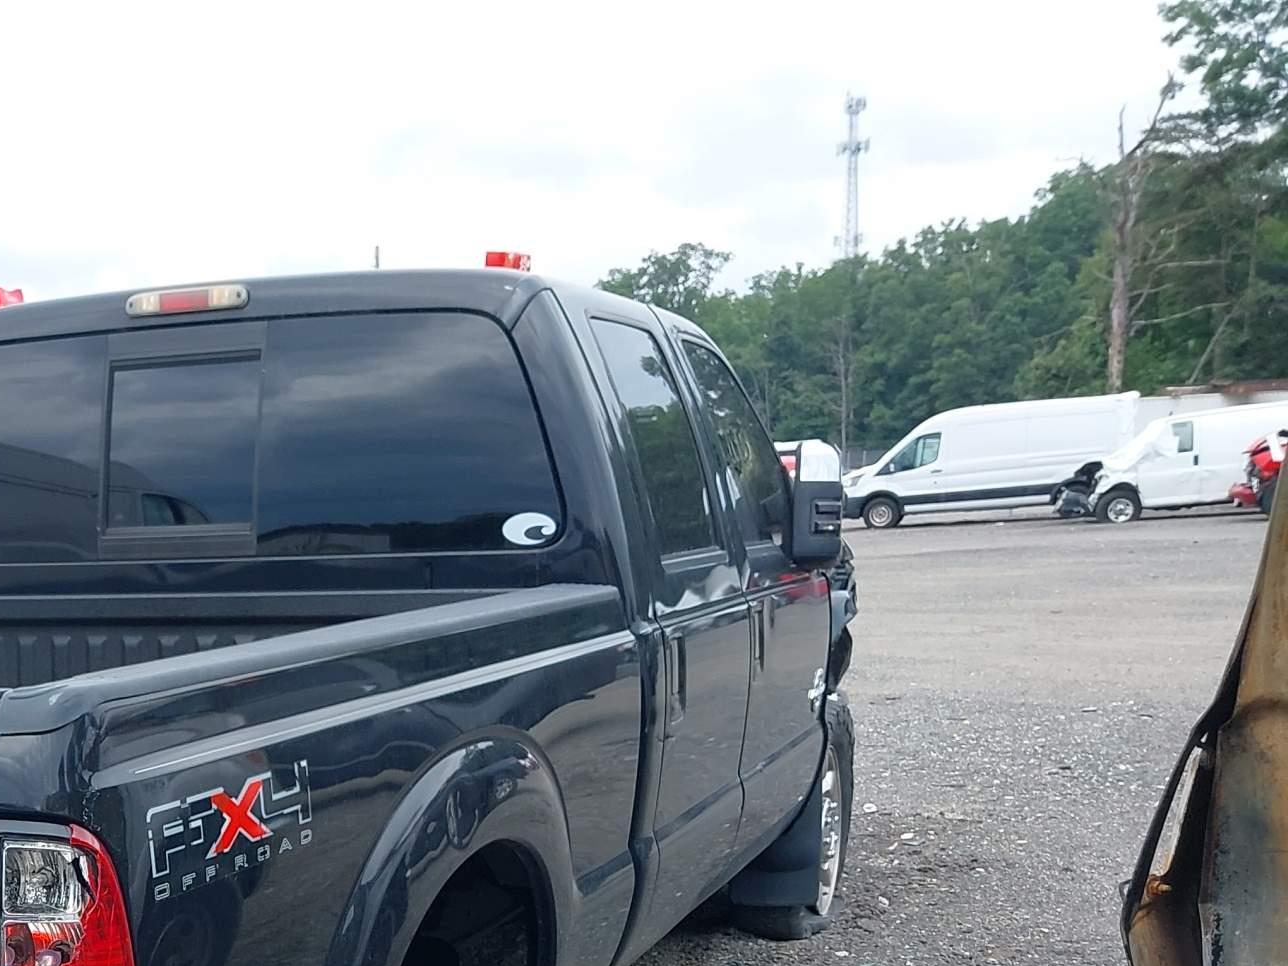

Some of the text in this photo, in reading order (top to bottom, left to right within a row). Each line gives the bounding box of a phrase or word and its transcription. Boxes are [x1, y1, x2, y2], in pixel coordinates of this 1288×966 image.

[146, 759, 312, 878] FX4
[154, 829, 313, 901] OFF ROAD
